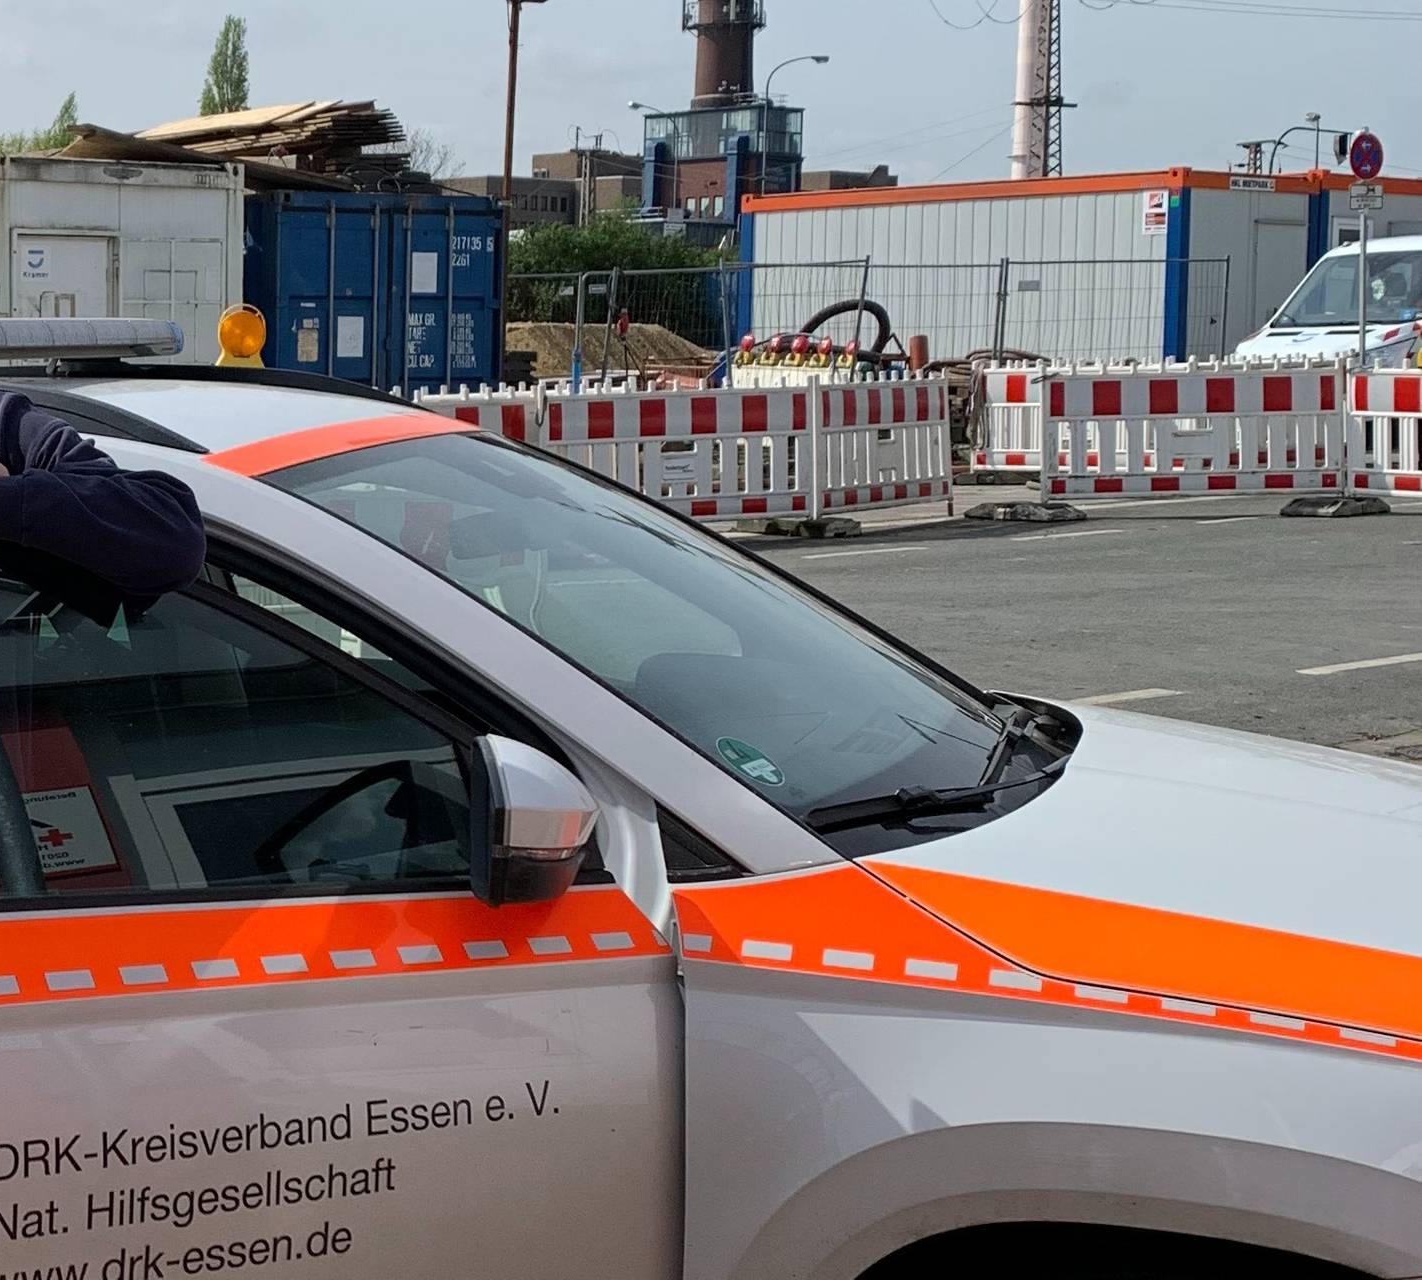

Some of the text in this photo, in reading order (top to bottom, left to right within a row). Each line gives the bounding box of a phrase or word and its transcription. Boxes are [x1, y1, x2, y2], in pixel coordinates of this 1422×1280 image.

[366, 1099, 472, 1136] Essen
[485, 1094, 515, 1122] e.
[525, 1080, 560, 1116] V.
[86, 1156, 397, 1230] Hilfsgesellschaft
